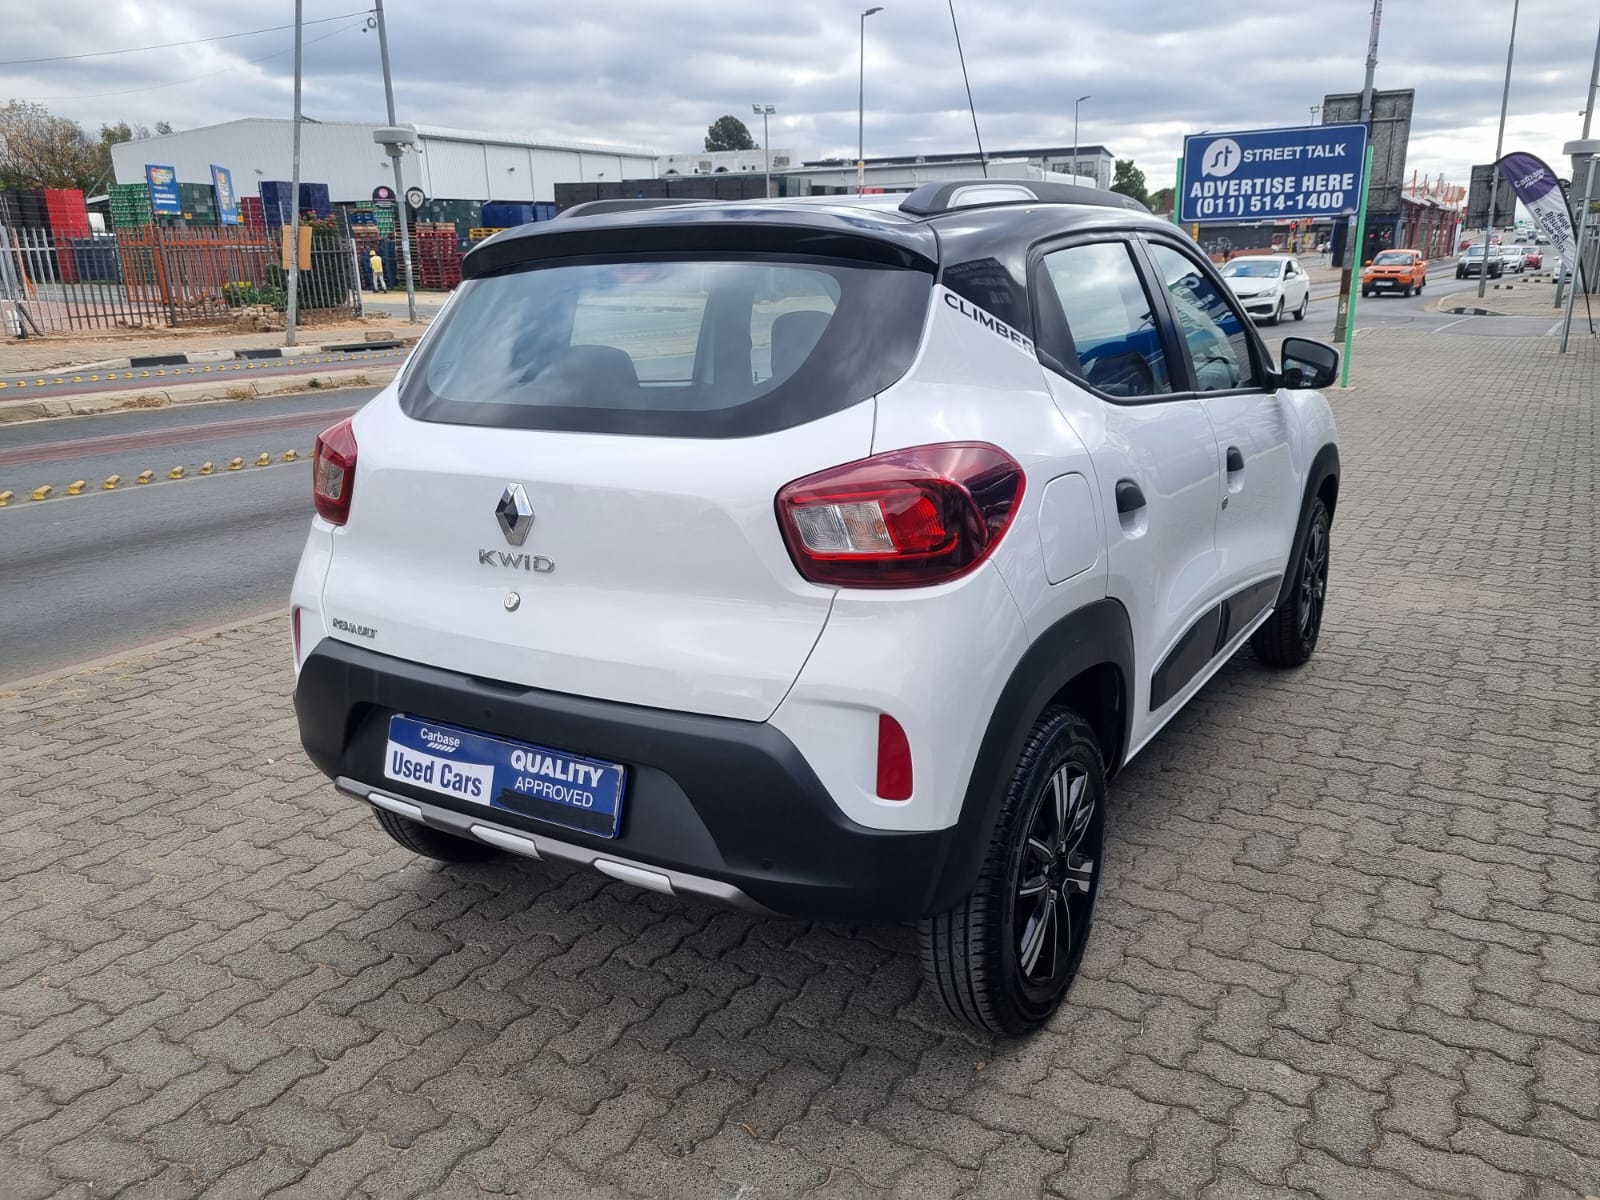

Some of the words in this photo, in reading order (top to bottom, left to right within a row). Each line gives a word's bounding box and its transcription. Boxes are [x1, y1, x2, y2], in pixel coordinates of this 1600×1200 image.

[1243, 146, 1304, 163] STREET
[1305, 143, 1347, 159] TALK
[1190, 176, 1296, 198] ADVERTISE
[1301, 173, 1354, 192] HERE
[1196, 197, 1244, 217] (011)
[1250, 191, 1344, 212] 514-1400
[944, 293, 1035, 356] CLIMBER
[478, 549, 555, 573] KWID
[420, 727, 460, 747] Carbase
[392, 750, 435, 784] Used
[440, 763, 482, 797] Cars
[510, 749, 604, 788] QUALITY
[514, 776, 594, 808] APPROVED
